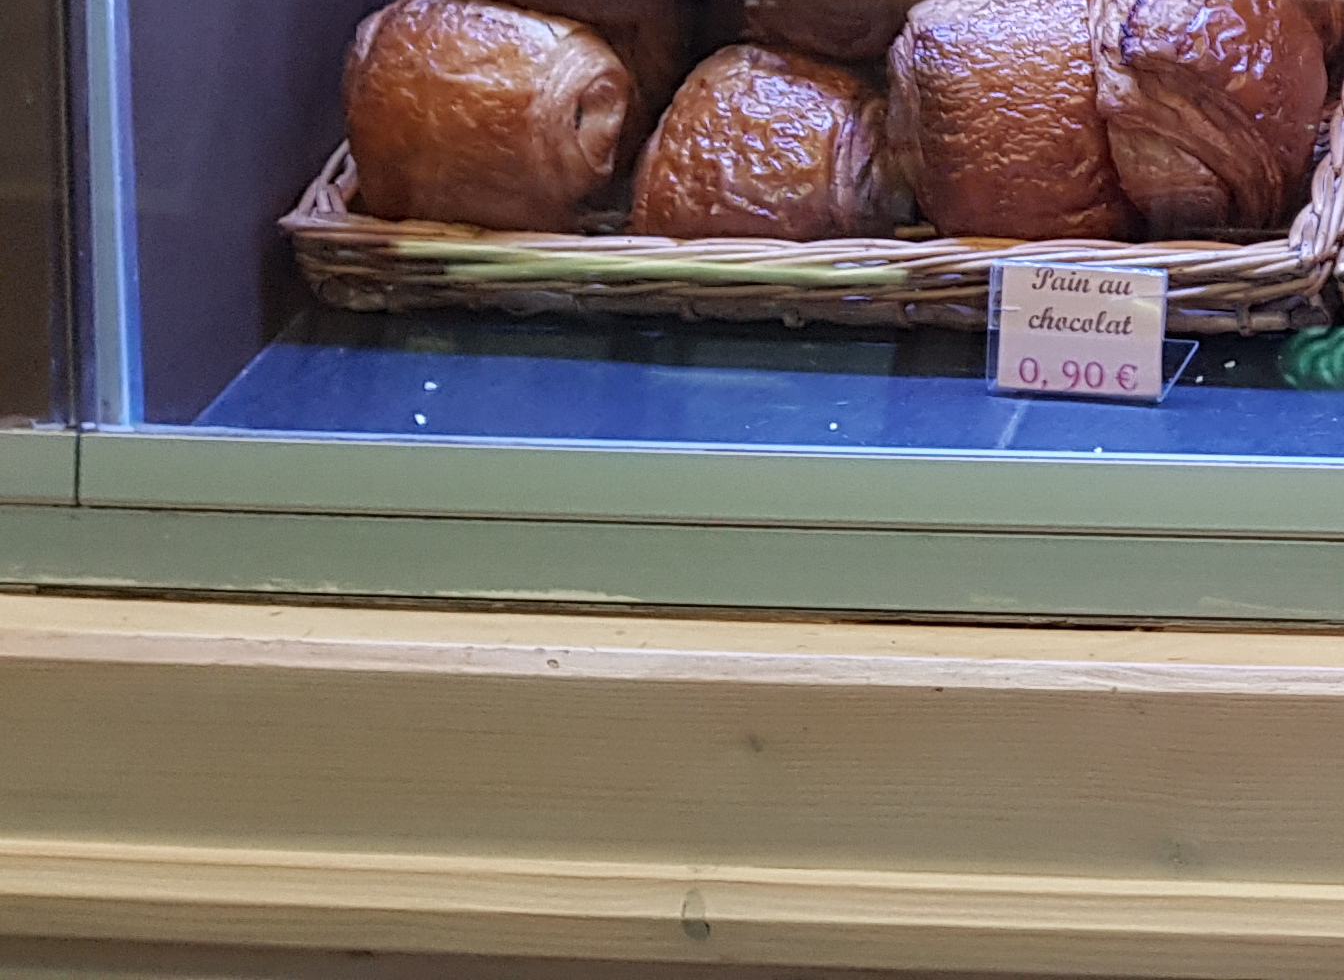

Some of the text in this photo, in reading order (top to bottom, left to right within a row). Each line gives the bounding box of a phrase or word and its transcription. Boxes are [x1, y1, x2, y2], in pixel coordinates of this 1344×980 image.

[1031, 266, 1134, 296] Pain au
[1028, 306, 1134, 336] chocolat
